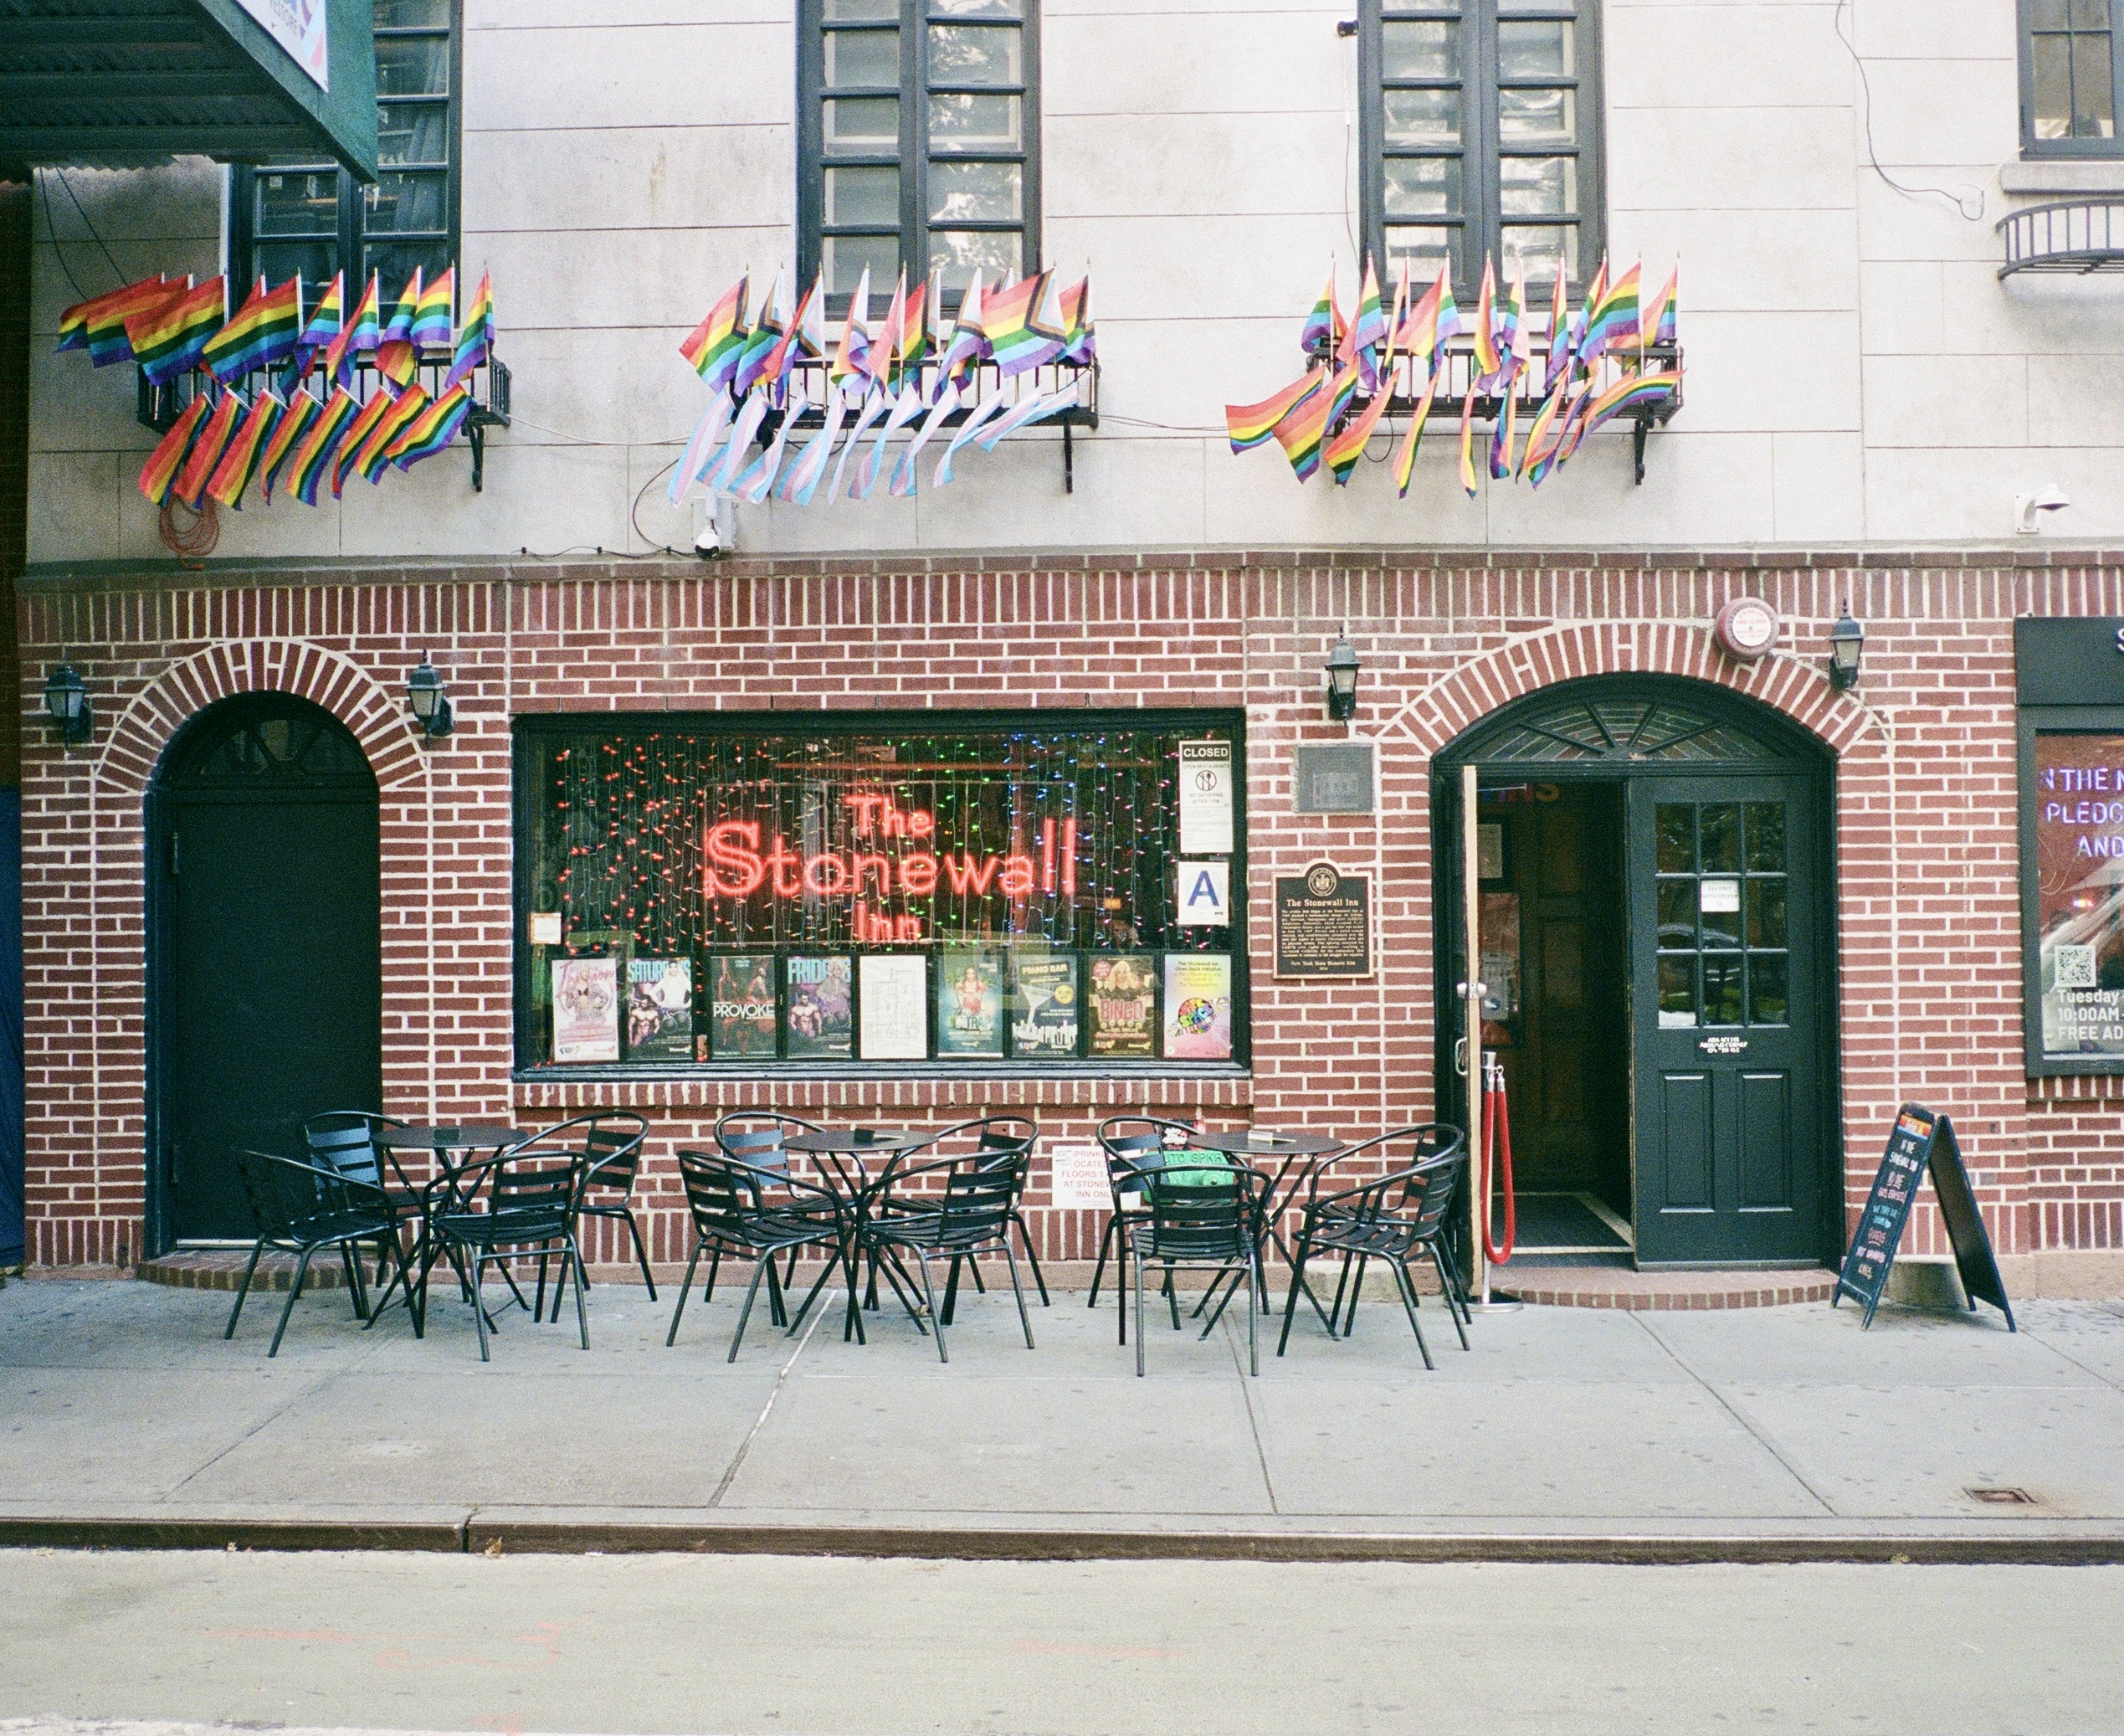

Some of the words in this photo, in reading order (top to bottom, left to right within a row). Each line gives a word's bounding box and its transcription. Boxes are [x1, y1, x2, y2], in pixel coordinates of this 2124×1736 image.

[1183, 747, 1229, 758] CLOSED
[2059, 768, 2109, 791] THE
[844, 794, 935, 837] The
[2077, 835, 2124, 858] AND
[704, 818, 1076, 900] Stonewall
[1187, 870, 1220, 907] A
[1286, 898, 1301, 907] The
[1304, 898, 1342, 907] Stonewall
[1346, 898, 1359, 907] Inn
[854, 901, 922, 942] Inn
[1049, 963, 1068, 973] BAR
[2057, 989, 2121, 1006] Tuesday
[713, 1004, 775, 1020] PROVOKE
[1100, 999, 1144, 1021] BINGO
[2057, 1007, 2121, 1022] 10:00AM
[2058, 1025, 2099, 1040] FREE
[1191, 1153, 1223, 1163] SPKR
